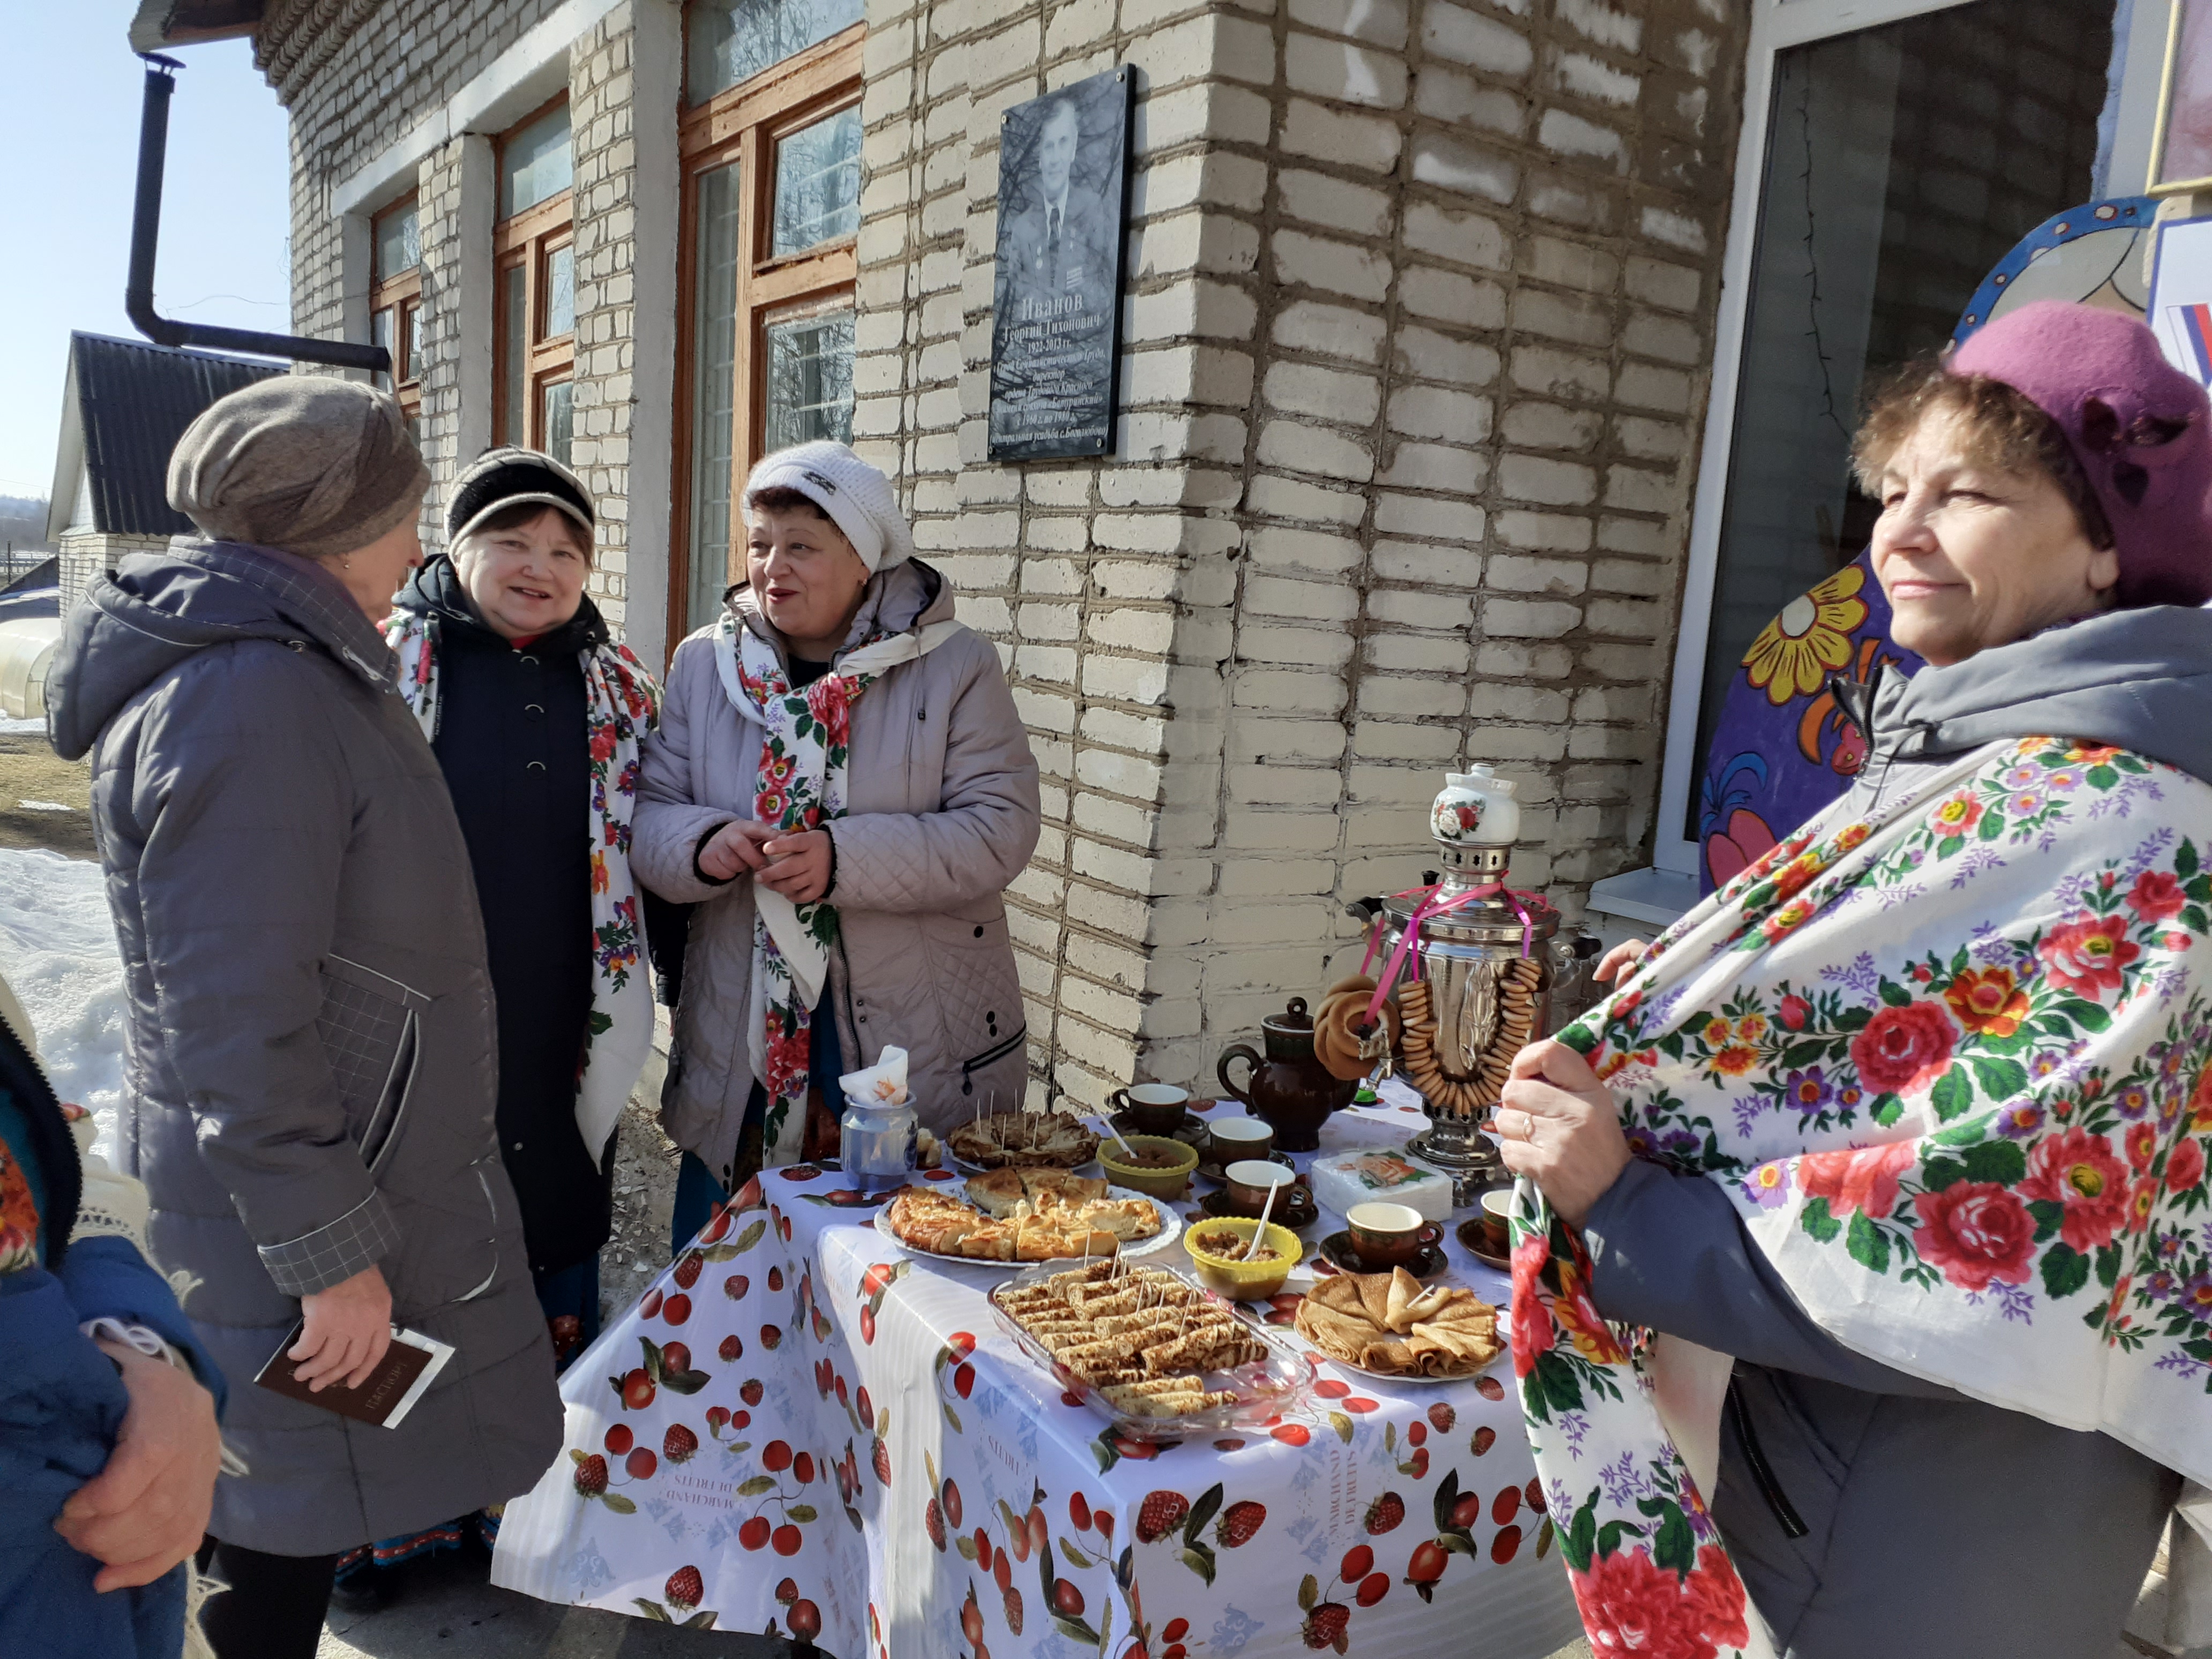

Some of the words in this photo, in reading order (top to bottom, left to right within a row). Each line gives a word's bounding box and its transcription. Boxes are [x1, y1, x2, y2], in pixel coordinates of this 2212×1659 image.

[1022, 295, 1082, 320] Иванов
[1004, 320, 1042, 343] Георгий
[1046, 314, 1101, 335] Тихонович
[1028, 338, 1061, 354] 1922-2013
[1033, 369, 1065, 384] директор
[1061, 381, 1094, 395] Красного
[1054, 410, 1070, 423] 1980
[1033, 430, 1058, 444] усадьба
[675, 1475, 715, 1490] FRUITS
[1346, 1451, 1357, 1503] FRUITS
[667, 1490, 734, 1509] MARCHAND
[1329, 1450, 1341, 1536] MARCHAND
